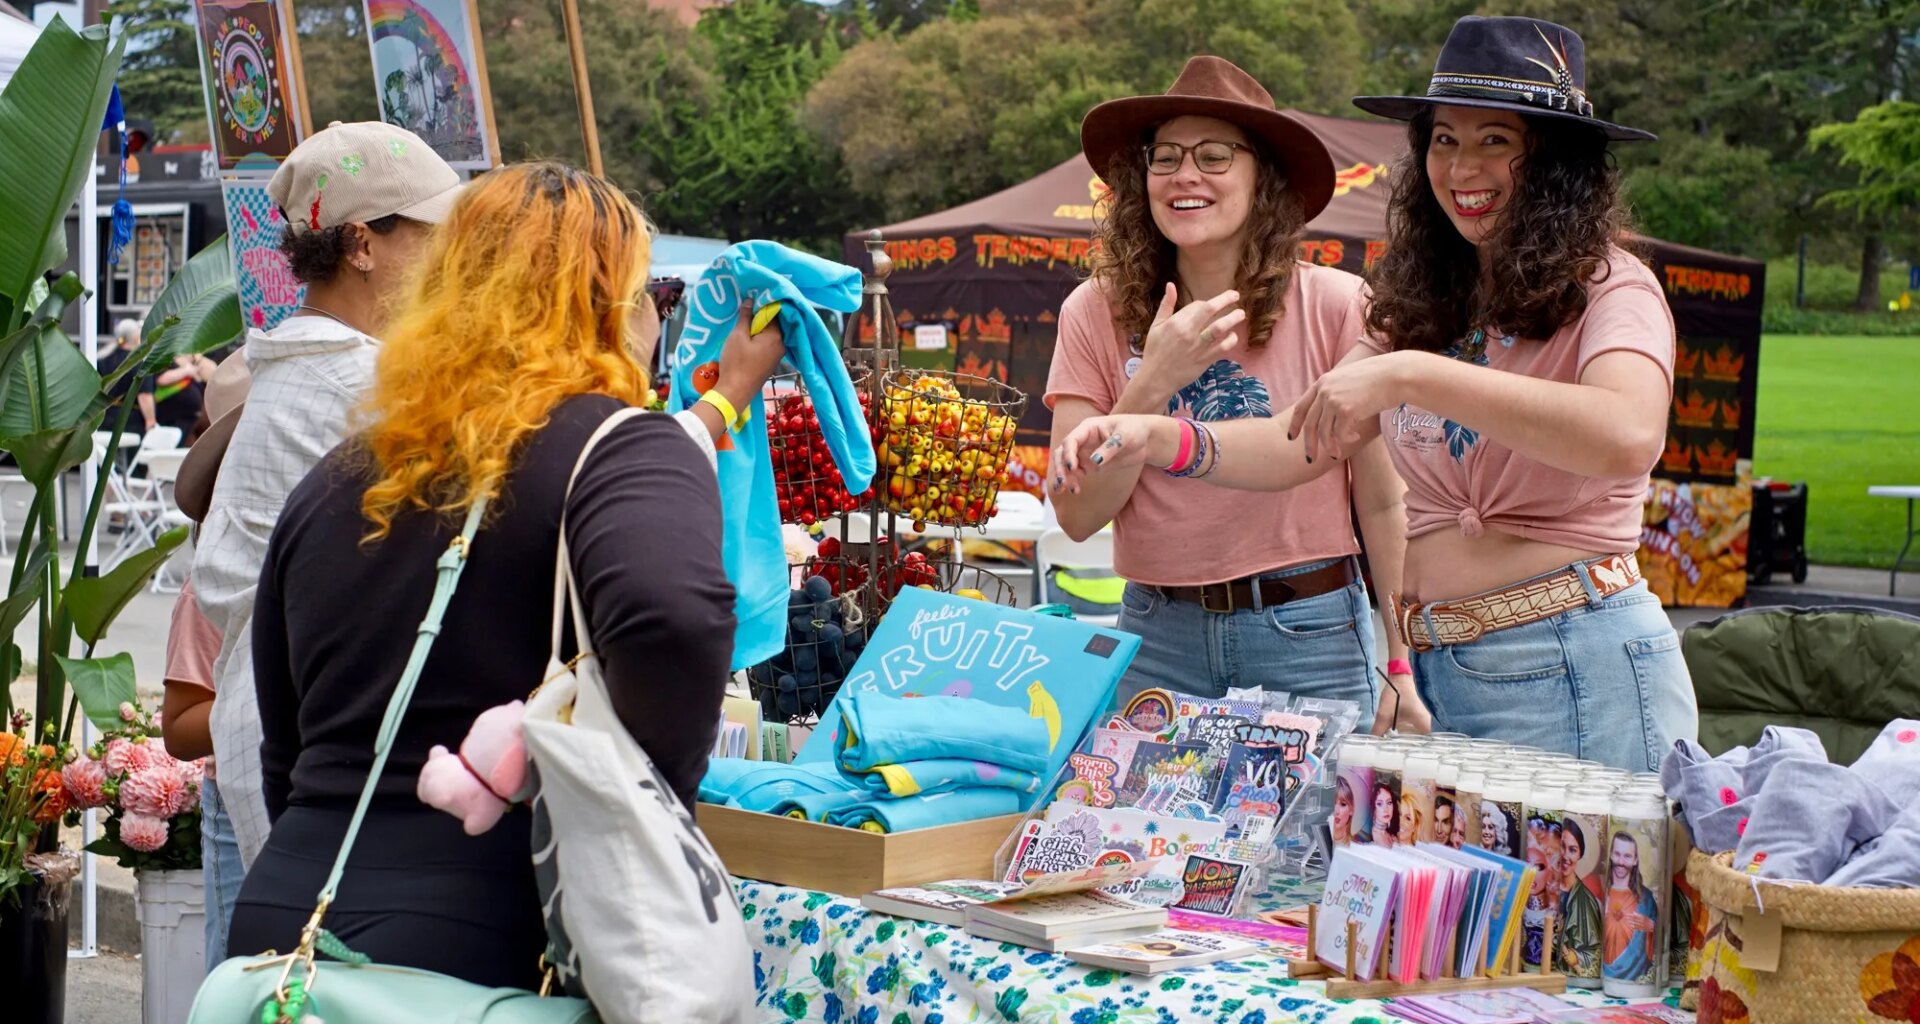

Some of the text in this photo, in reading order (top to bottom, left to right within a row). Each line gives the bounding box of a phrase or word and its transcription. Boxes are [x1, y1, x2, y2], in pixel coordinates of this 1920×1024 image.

[1664, 265, 1751, 299] TENDERS
[263, 286, 298, 306] KIDS
[908, 604, 971, 640] feelin
[846, 621, 1051, 697] FRUITY
[1179, 703, 1228, 718] BLACK
[1198, 717, 1214, 728] NO
[1209, 726, 1237, 739] FREE
[1236, 725, 1303, 746] TRANS
[1072, 756, 1114, 772] Born
[1079, 767, 1105, 780] this
[1041, 837, 1083, 856] Girls
[1048, 849, 1088, 866] Gays
[1184, 859, 1242, 883] JOY
[1342, 873, 1379, 900] Make
[1180, 887, 1234, 913] ESISTANCE
[1325, 889, 1374, 917] America
